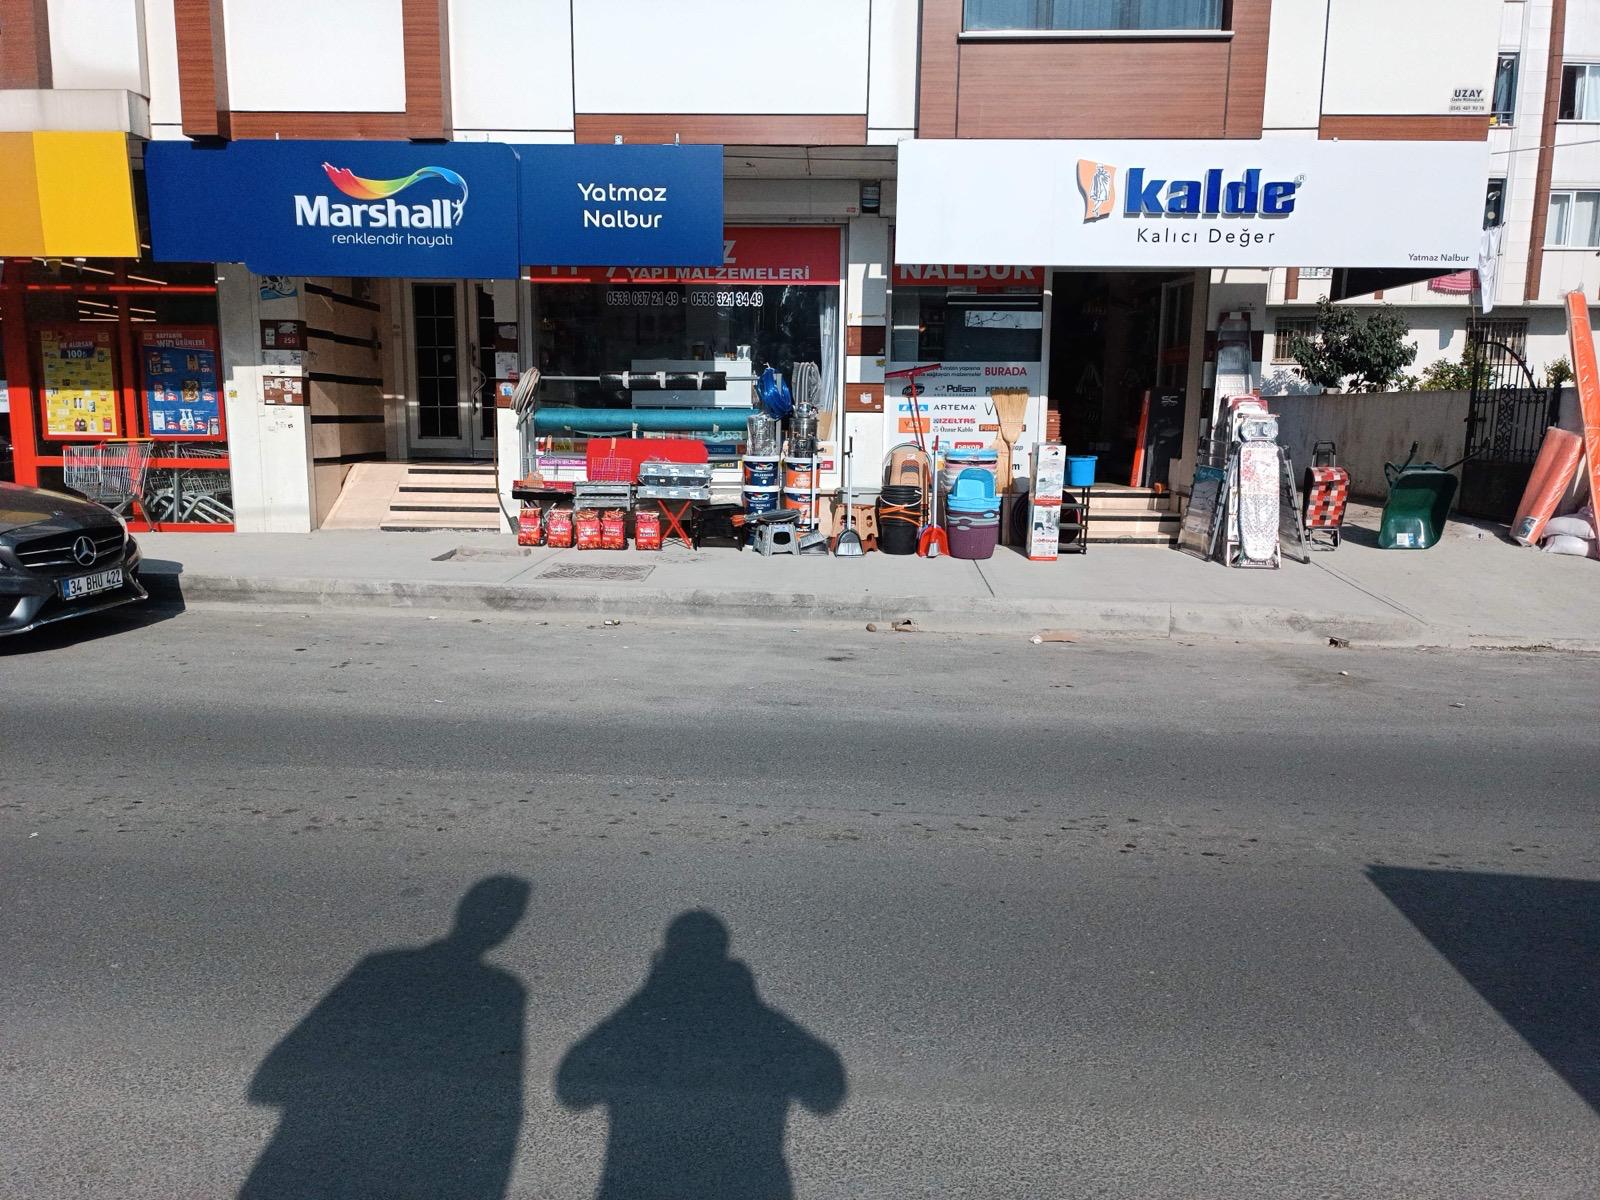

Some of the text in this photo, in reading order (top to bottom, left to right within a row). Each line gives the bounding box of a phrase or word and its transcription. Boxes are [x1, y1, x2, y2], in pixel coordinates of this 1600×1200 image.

[1454, 89, 1482, 98] UZAY
[577, 182, 667, 201] Yatmaz
[1124, 168, 1297, 219] kalde
[294, 195, 453, 229] Marshall
[583, 209, 663, 228] Nalbur
[332, 232, 453, 248] renklendir hayatı
[1137, 226, 1276, 247] Kalıcı Değer
[1408, 253, 1470, 262] Yatmaz Nalbur
[626, 267, 669, 279] YAPI
[675, 265, 810, 280] MALZEMELERİ
[900, 264, 1035, 280] NALBUR
[606, 291, 631, 306] 0533
[632, 291, 651, 306] 037
[651, 291, 664, 306] 21
[664, 291, 679, 306] 49
[690, 291, 716, 306] 0536
[716, 291, 735, 307] 321
[735, 291, 749, 307] 34
[749, 291, 764, 307] 49
[985, 366, 1028, 376] BURADA
[946, 384, 977, 393] Polisan
[70, 569, 121, 594] 34 BHU 422
